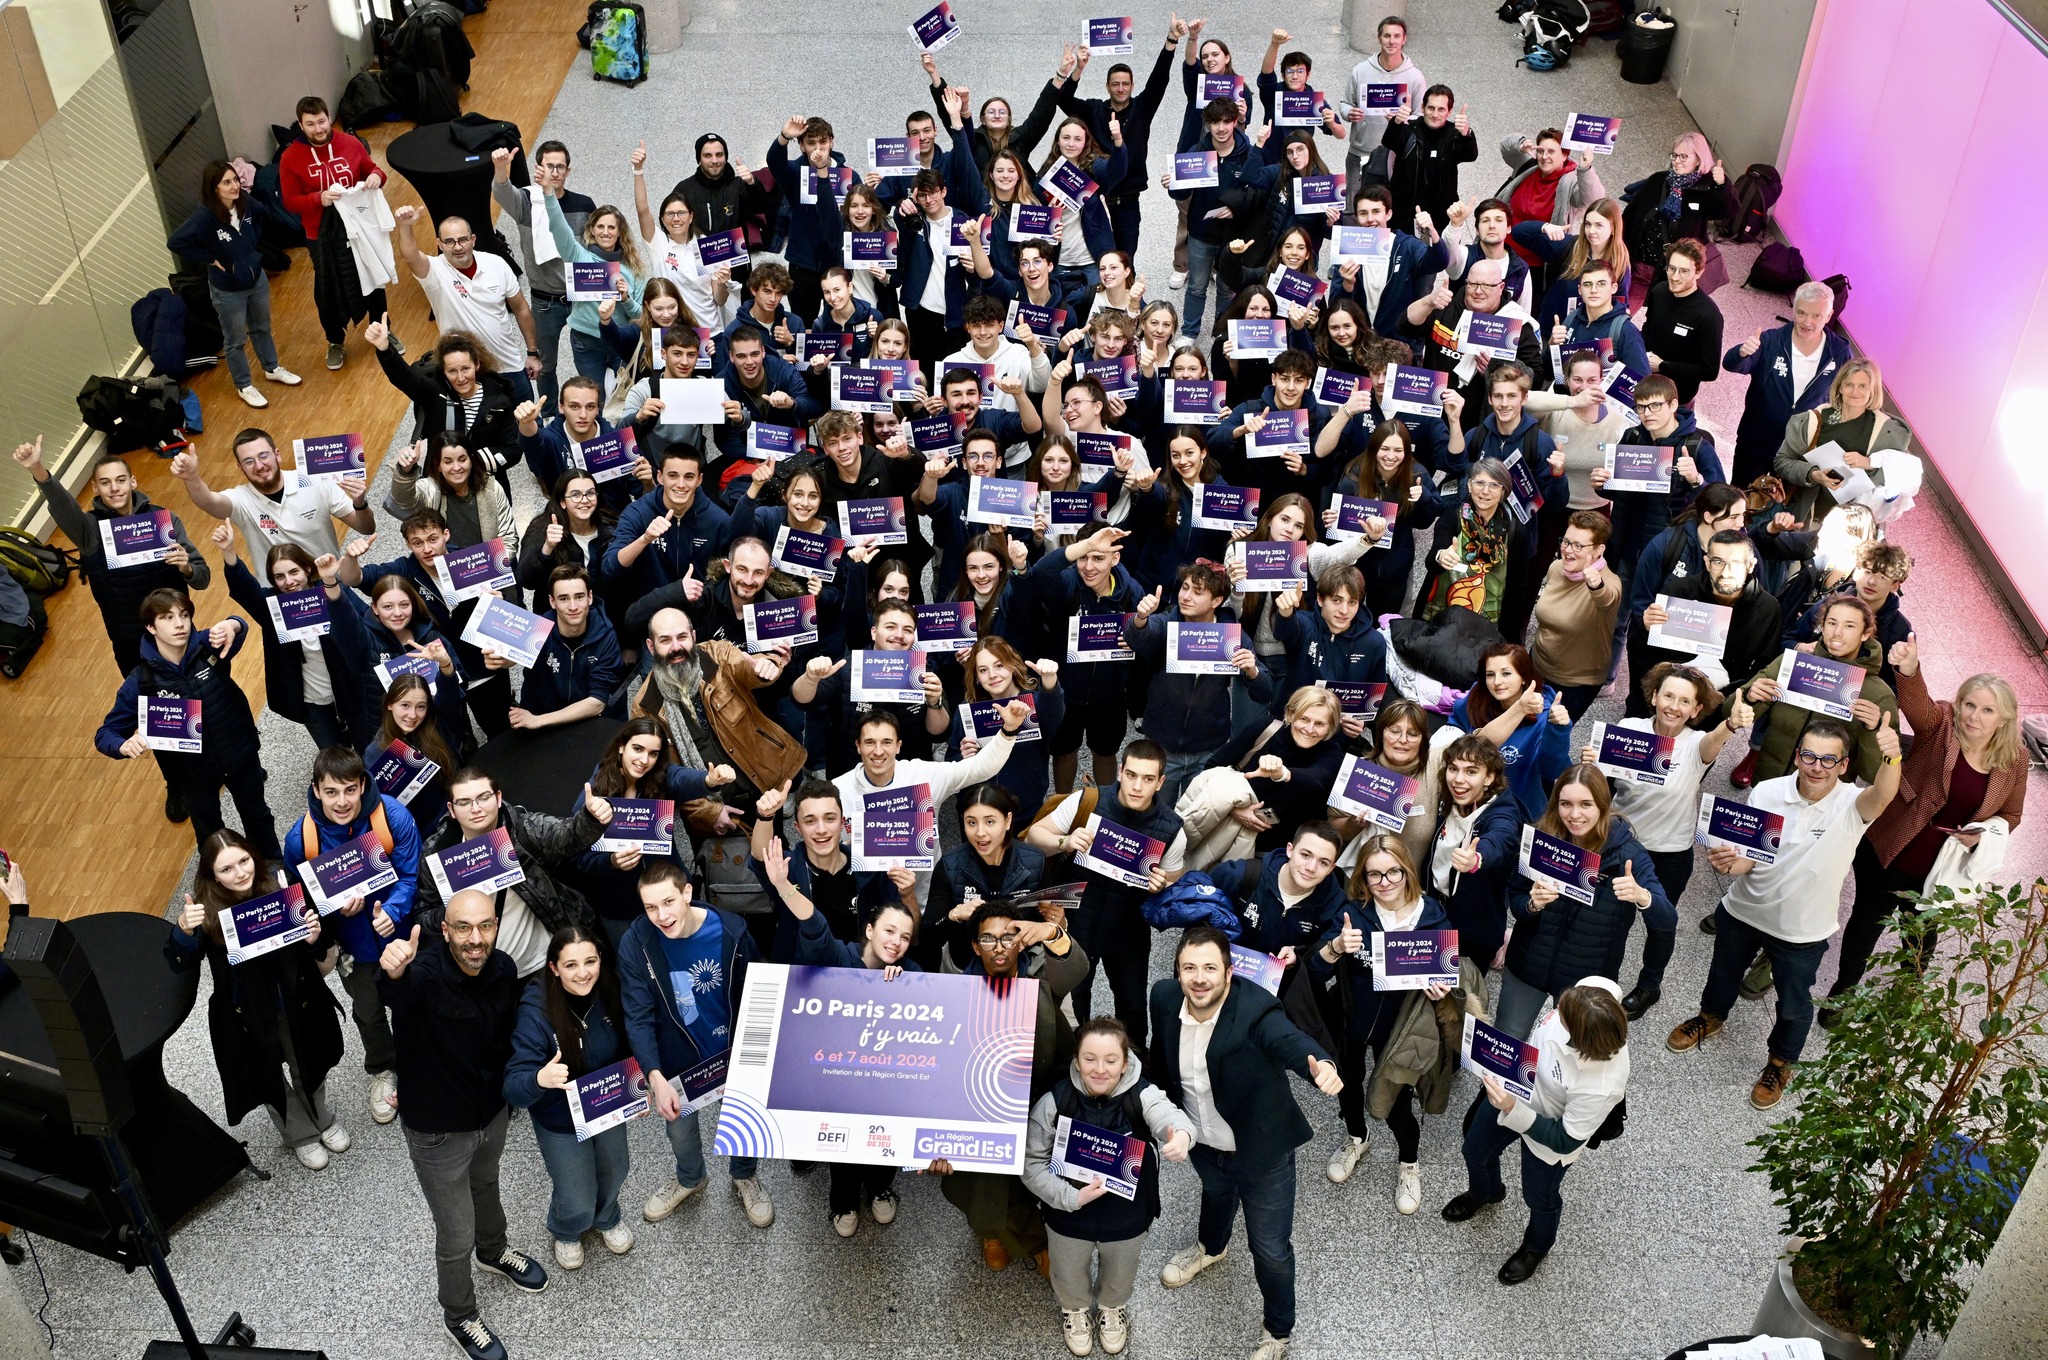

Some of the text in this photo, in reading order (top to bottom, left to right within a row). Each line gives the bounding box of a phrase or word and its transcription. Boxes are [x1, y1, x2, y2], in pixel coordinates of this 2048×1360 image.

[308, 156, 353, 192] 76
[1615, 735, 1632, 744] Paris
[1363, 770, 1379, 781] Paris
[1379, 776, 1394, 786] 2024
[1724, 808, 1741, 818] Paris
[1742, 813, 1758, 822] 2024
[444, 844, 486, 865] JO Paris 2024
[1544, 842, 1559, 853] Paris
[1560, 849, 1575, 859] 2024
[316, 849, 357, 872] JO Paris 2024
[236, 901, 279, 921] JO Paris 2024
[792, 998, 944, 1022] JO Paris 2024
[859, 1019, 962, 1051] j'y vais !
[1484, 1034, 1498, 1045] Paris
[1499, 1041, 1514, 1052] 2024
[814, 1050, 937, 1068] 6 et 7 août 2024
[822, 1068, 852, 1076] Invitation
[854, 1069, 863, 1077] de
[872, 1070, 895, 1079] Région
[897, 1072, 917, 1080] Grand
[580, 1072, 619, 1094] JO Paris 2024
[818, 1132, 846, 1142] DEFI
[869, 1125, 884, 1134] 20
[946, 1133, 974, 1142] Région
[1082, 1132, 1100, 1143] Paris
[1100, 1138, 1117, 1148] 2024
[882, 1148, 895, 1157] 24
